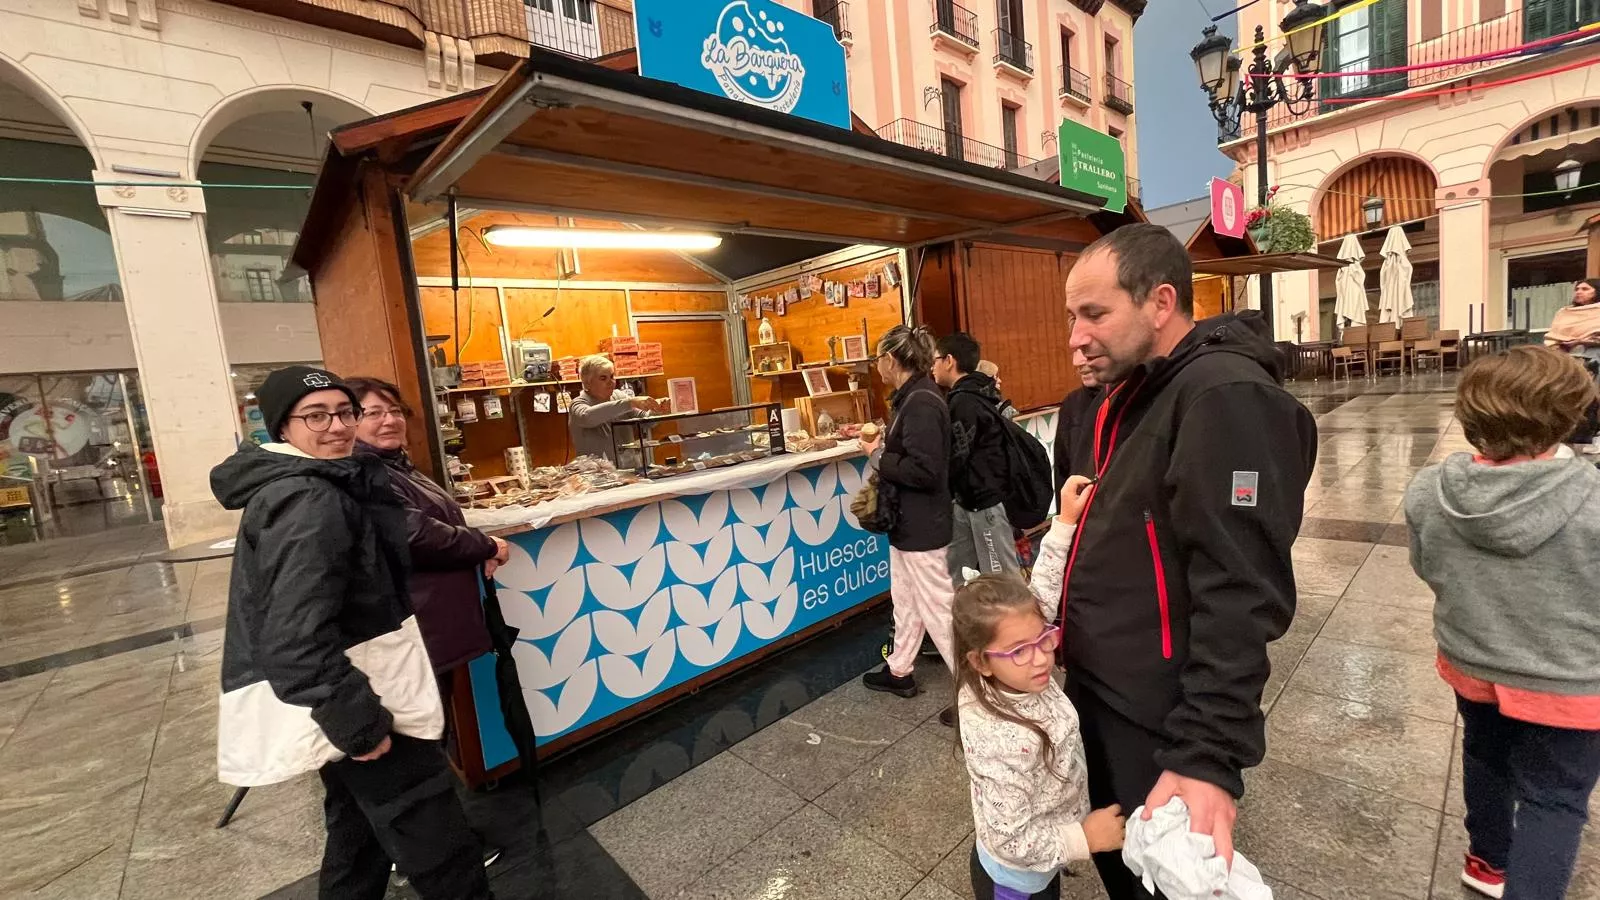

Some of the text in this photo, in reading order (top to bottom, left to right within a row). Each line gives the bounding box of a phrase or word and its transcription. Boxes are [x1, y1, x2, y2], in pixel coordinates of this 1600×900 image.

[705, 38, 803, 82] La Barquera
[717, 73, 746, 103] Panad
[799, 535, 879, 580] Huesca
[803, 560, 889, 610] es dulce
